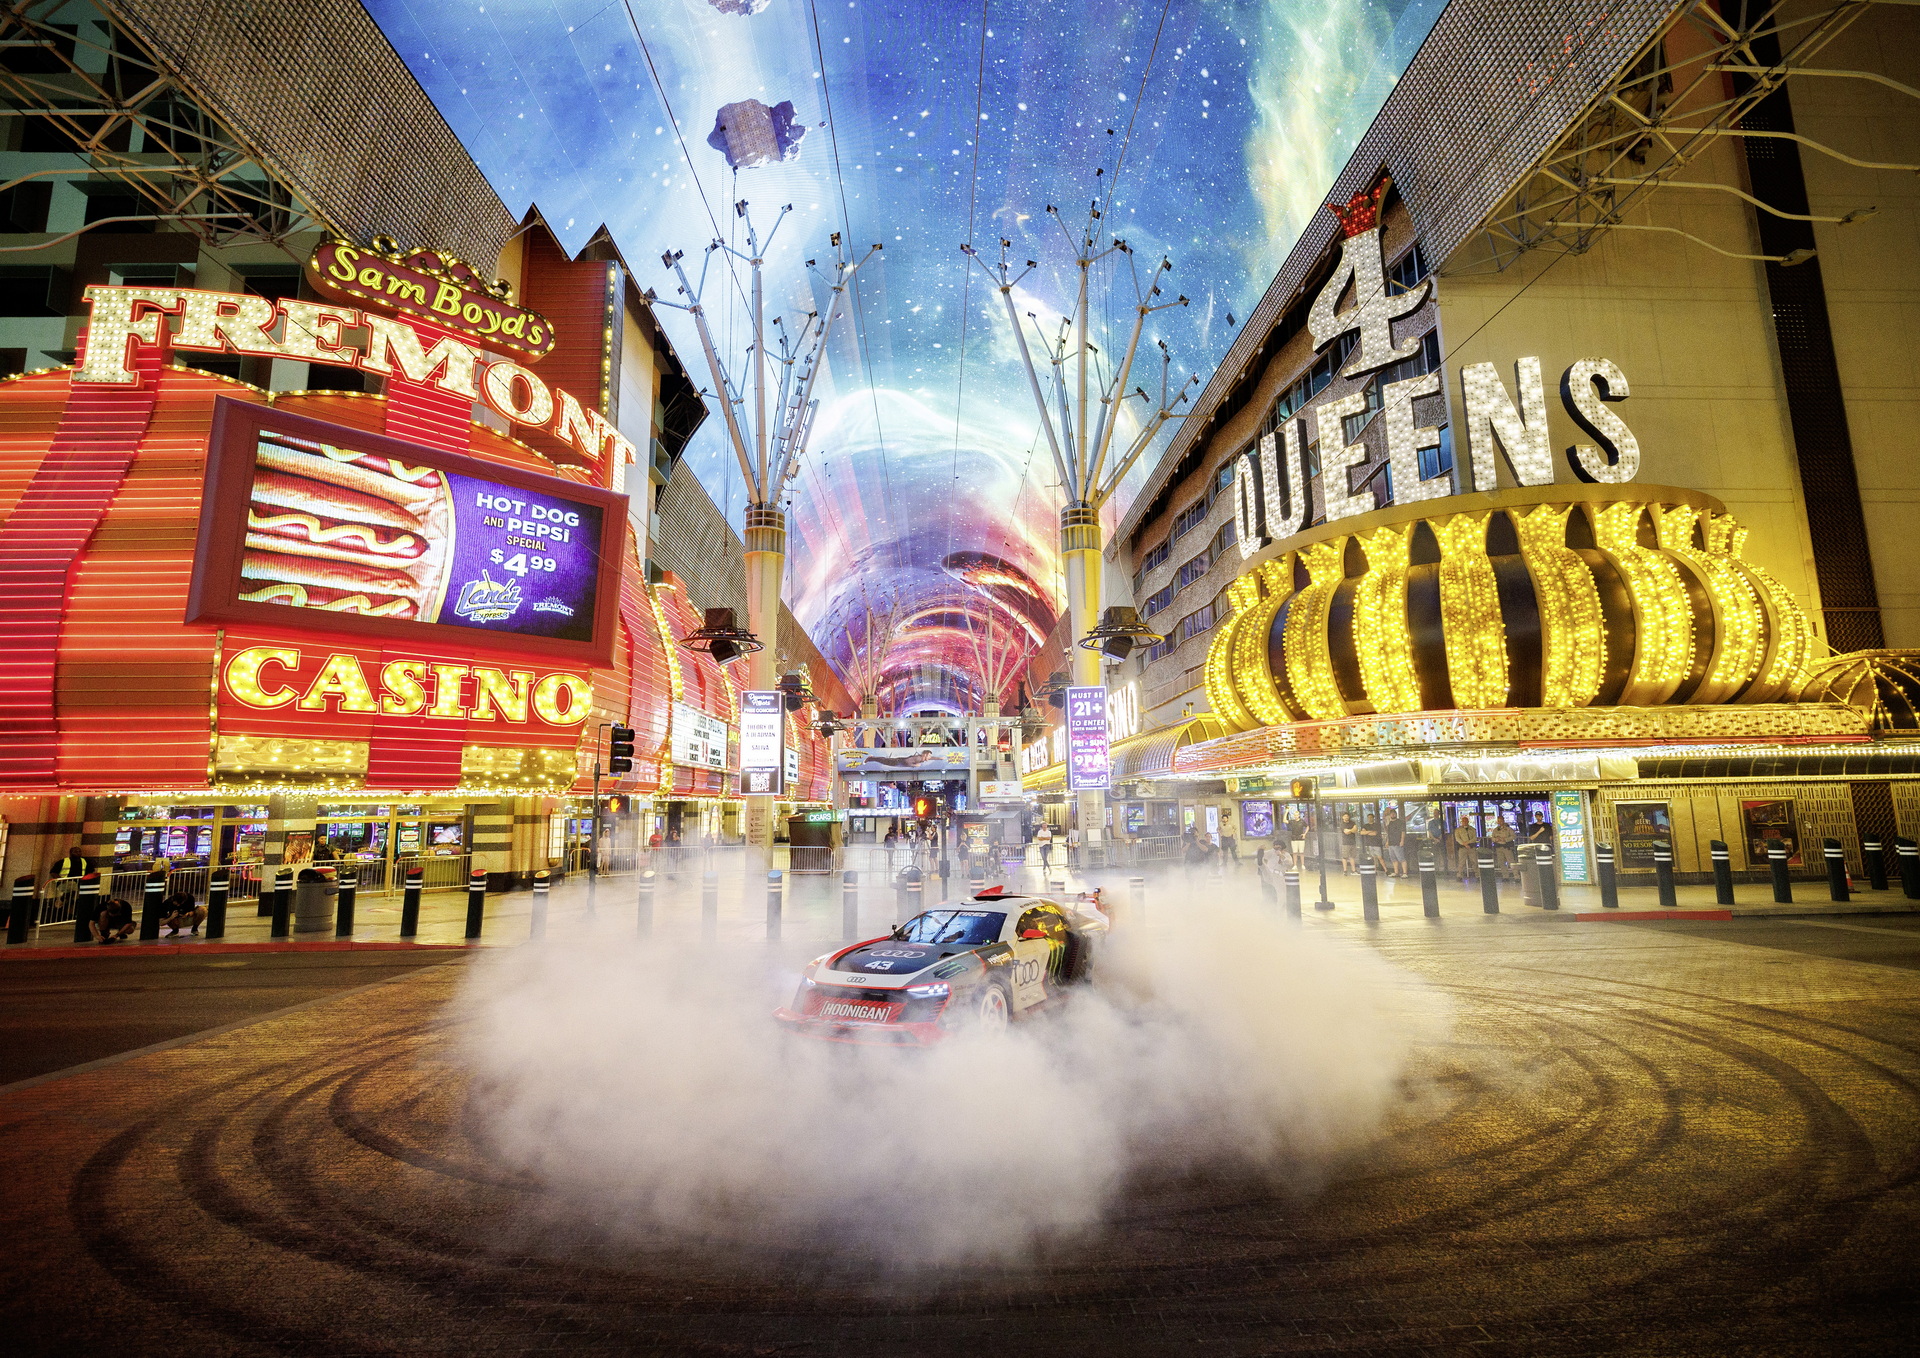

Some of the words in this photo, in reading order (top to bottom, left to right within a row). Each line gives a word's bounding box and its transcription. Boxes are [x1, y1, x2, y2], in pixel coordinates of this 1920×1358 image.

[328, 246, 427, 306] Sam
[430, 282, 544, 346] Boyd's
[1308, 227, 1432, 380] 4
[71, 285, 637, 493] FREMONT
[1234, 356, 1640, 561] QUEENS
[476, 492, 526, 516] HOT
[531, 504, 580, 527] DOG
[483, 515, 505, 528] AND
[507, 517, 570, 543] PEPSI
[506, 535, 547, 551] SPECIAL
[533, 602, 575, 617] FREMONT
[224, 645, 593, 727] CASINO
[1074, 701, 1102, 716] 21+
[809, 813, 832, 821] CIGARS
[1560, 811, 1578, 825] $5
[1560, 842, 1585, 850] PLAY
[865, 960, 894, 970] 43
